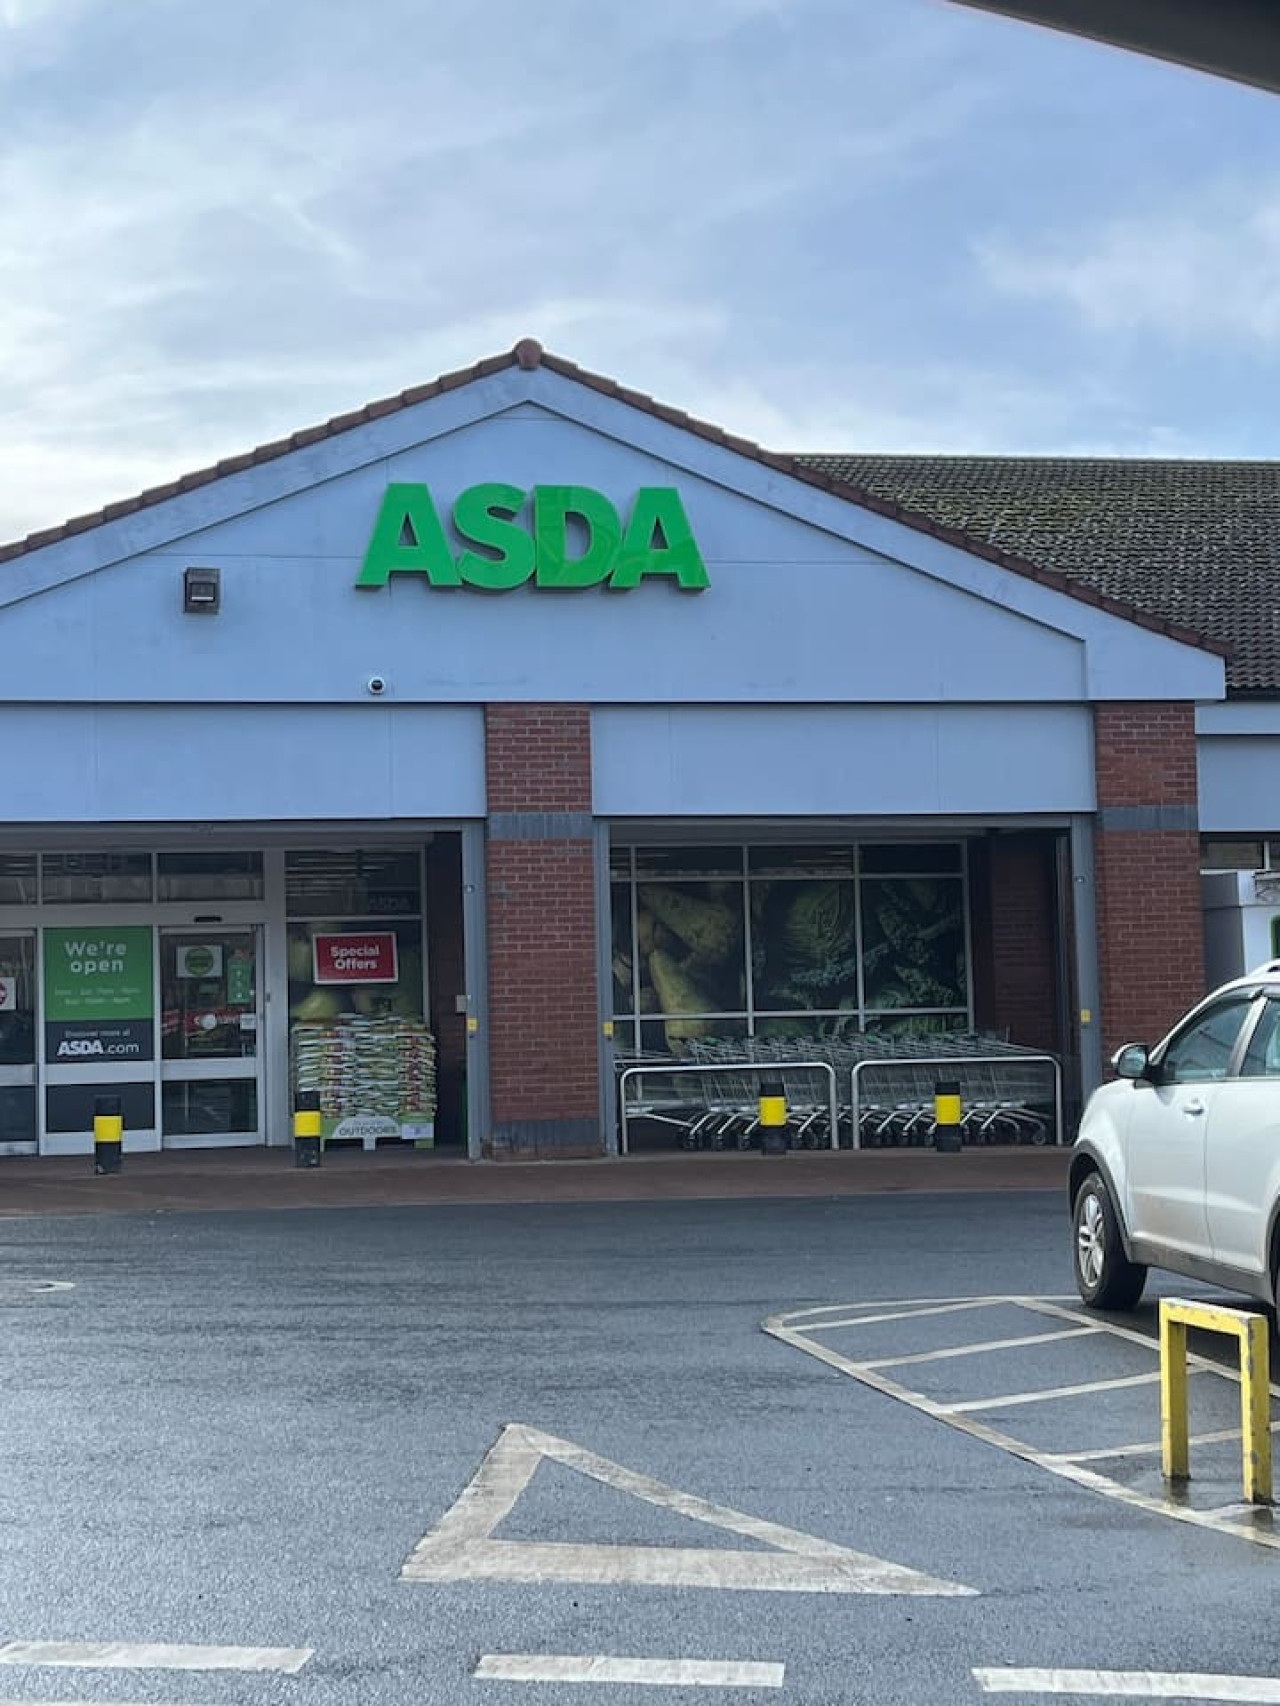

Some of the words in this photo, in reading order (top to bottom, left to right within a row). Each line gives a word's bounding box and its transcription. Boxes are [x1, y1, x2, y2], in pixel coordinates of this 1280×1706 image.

[355, 483, 711, 592] ASDA
[64, 941, 127, 957] We're
[330, 945, 379, 961] Special
[70, 959, 124, 976] open
[335, 957, 378, 970] Offers
